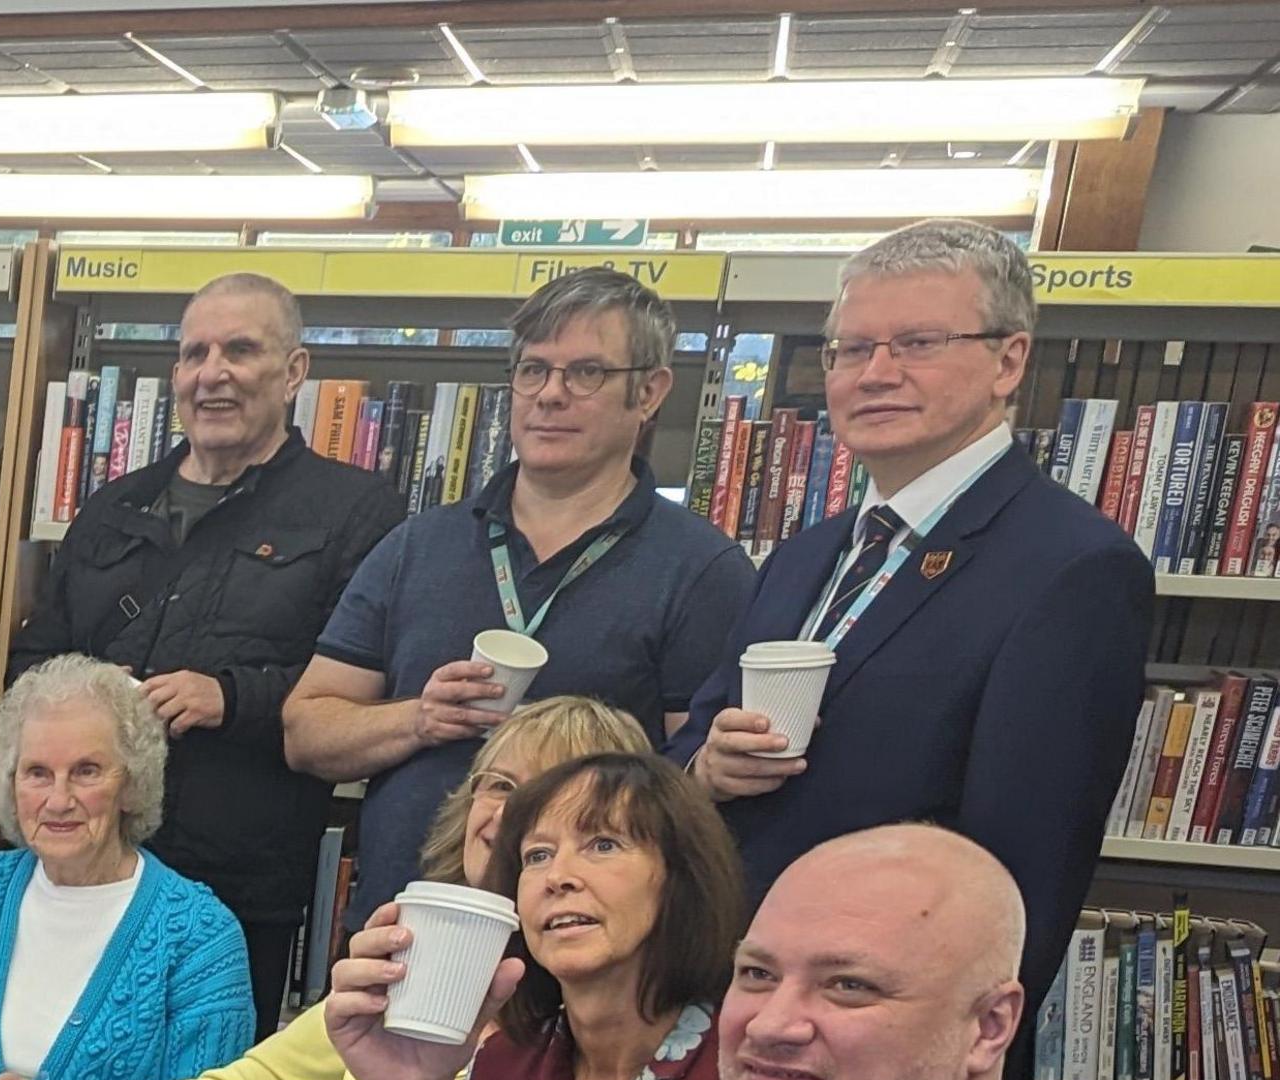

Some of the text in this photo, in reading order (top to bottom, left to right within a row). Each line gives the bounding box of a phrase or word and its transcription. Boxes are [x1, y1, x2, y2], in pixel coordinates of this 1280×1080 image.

[511, 229, 542, 243] exit
[66, 257, 139, 279] Music
[628, 260, 669, 284] TV
[1031, 264, 1133, 292] Sports
[695, 428, 713, 480] CALVIN
[1056, 434, 1073, 467] LOFTY
[1165, 440, 1194, 507] TORTURED
[1214, 440, 1241, 527] KEVIN KEEGAN
[1236, 431, 1268, 527] KEEGAN DALGLISH
[1234, 685, 1274, 769] PETER SCHMEICHEL
[1079, 965, 1097, 1034] ENGLAND
[1172, 978, 1187, 1034] MARATHON
[1220, 979, 1239, 1031] ENDURANCE
